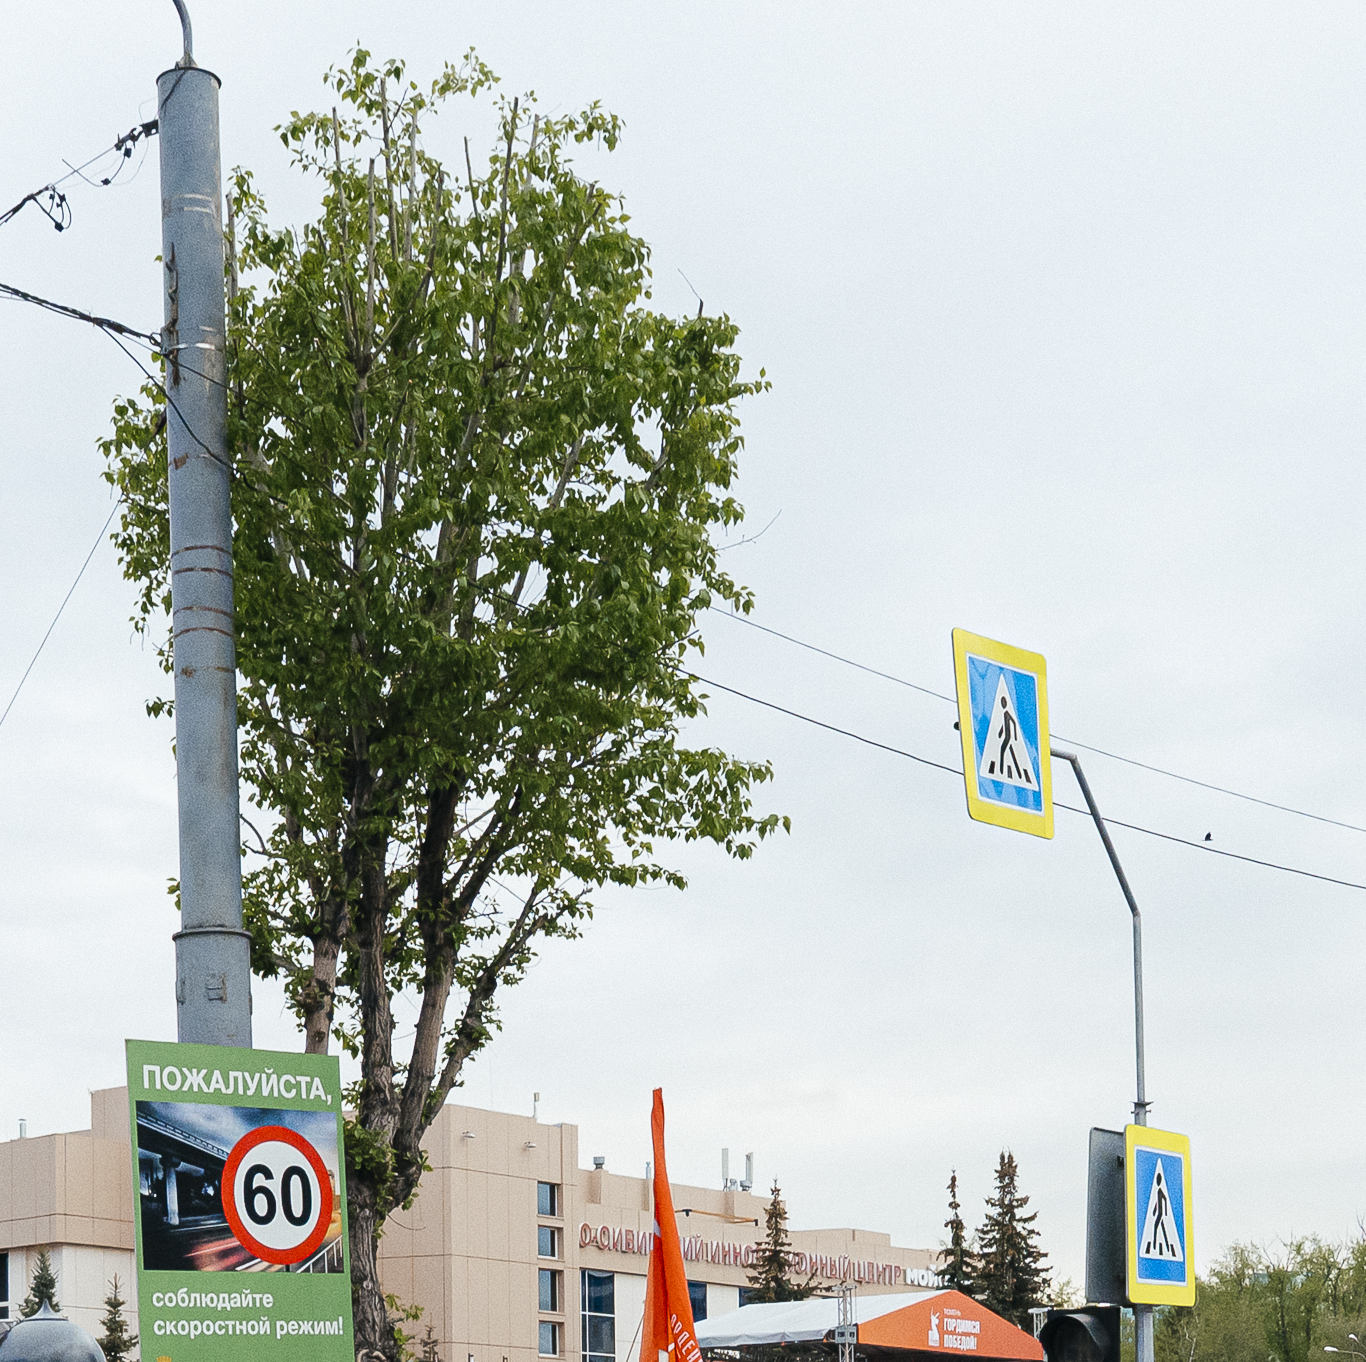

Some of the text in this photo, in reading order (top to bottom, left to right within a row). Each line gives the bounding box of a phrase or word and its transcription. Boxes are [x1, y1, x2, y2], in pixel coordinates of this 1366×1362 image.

[142, 1064, 333, 1106] ПОЖАЛУЙСТА,
[243, 1163, 313, 1228] 60
[152, 1287, 275, 1311] соблюдайте
[153, 1314, 344, 1339] скоростной режим!
